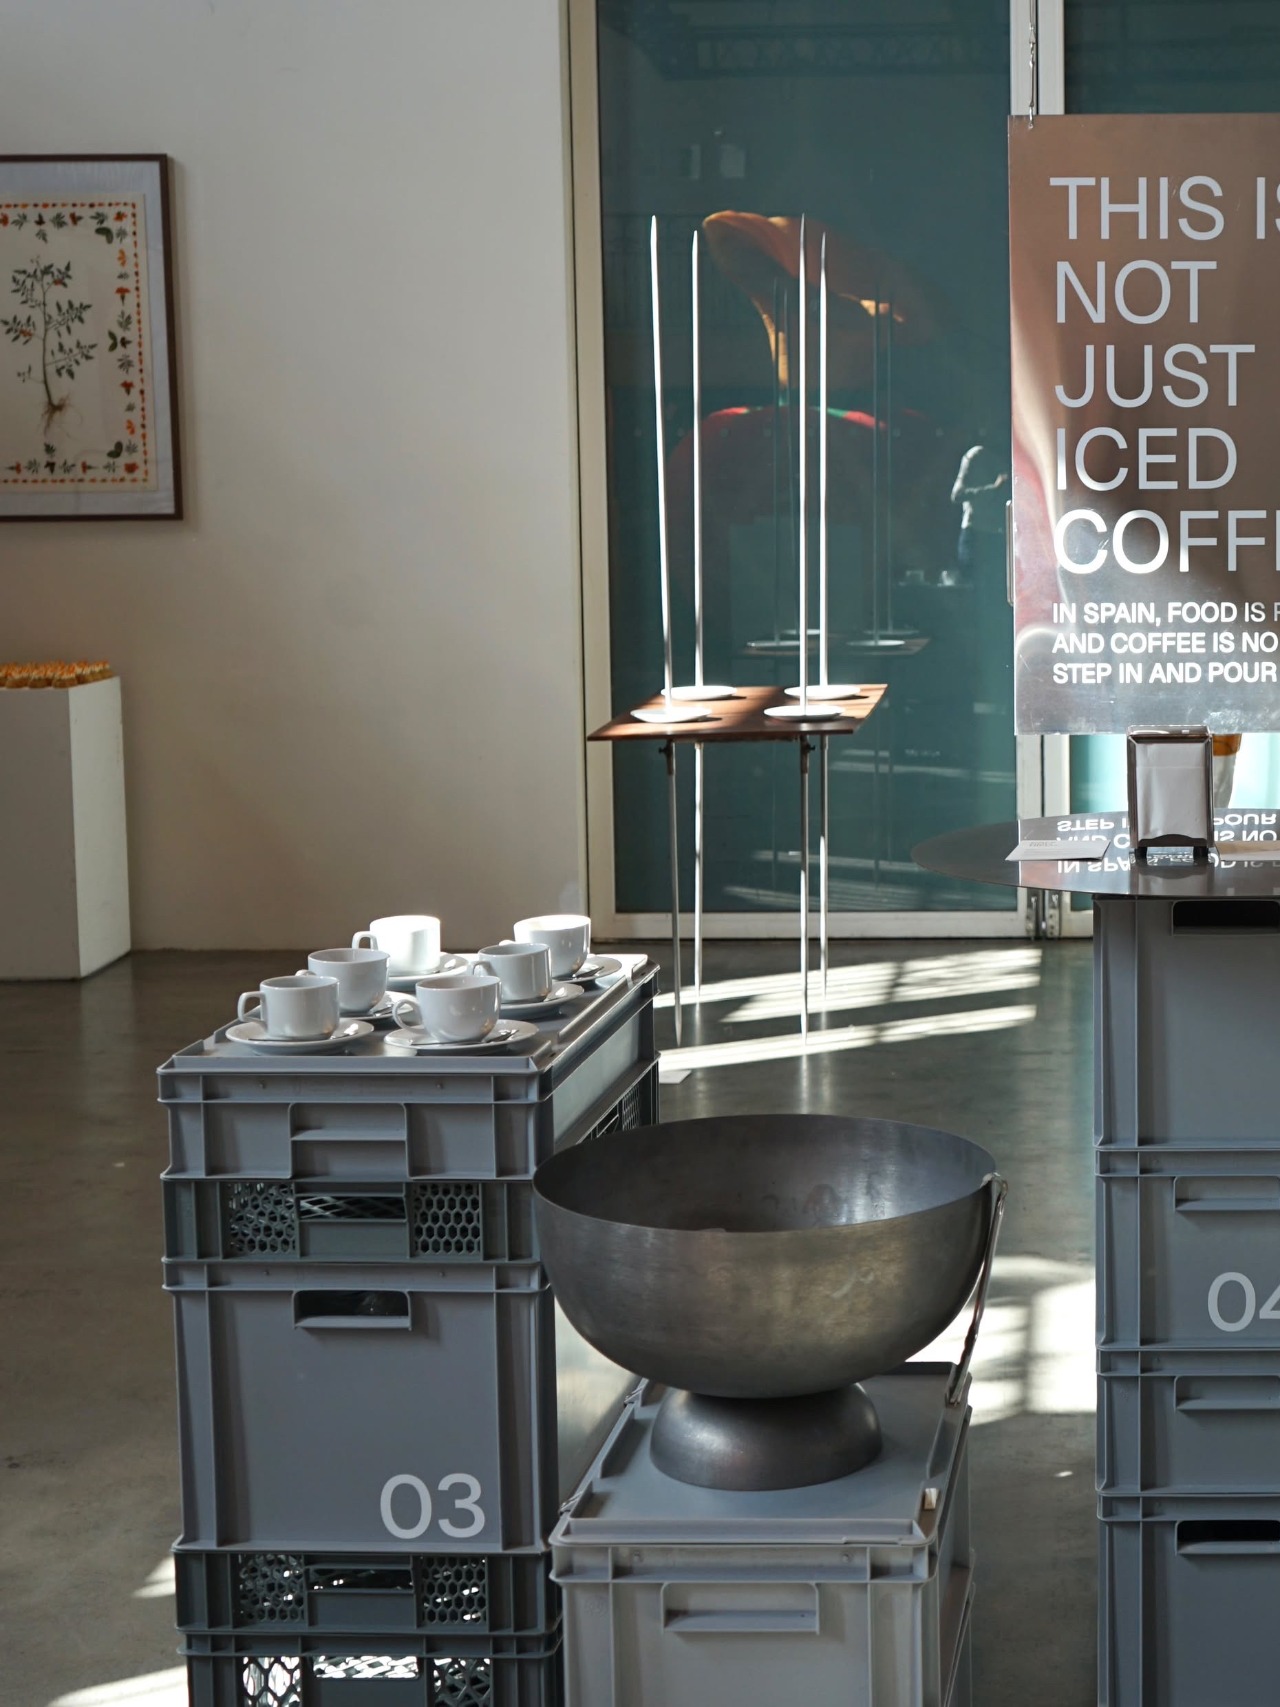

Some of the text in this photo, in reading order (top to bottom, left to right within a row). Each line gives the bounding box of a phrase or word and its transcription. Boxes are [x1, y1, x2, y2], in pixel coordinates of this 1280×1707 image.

[1050, 175, 1225, 241] THIS
[1056, 259, 1217, 325] NOT
[1054, 343, 1256, 408] JUST
[1056, 427, 1237, 491] ICED
[1052, 633, 1105, 654] AND
[1110, 632, 1206, 653] COFFEE
[1213, 632, 1235, 653] IS
[1242, 632, 1279, 652] NO
[1053, 603, 1076, 624] IN
[1083, 602, 1162, 627] SPAIN,
[1167, 602, 1238, 623] FOOD
[1244, 602, 1266, 622] IS
[1052, 663, 1112, 684] STEP
[1118, 663, 1143, 684] IN
[1149, 663, 1202, 683] AND
[1208, 662, 1278, 683] POUR
[379, 1473, 486, 1539] 03
